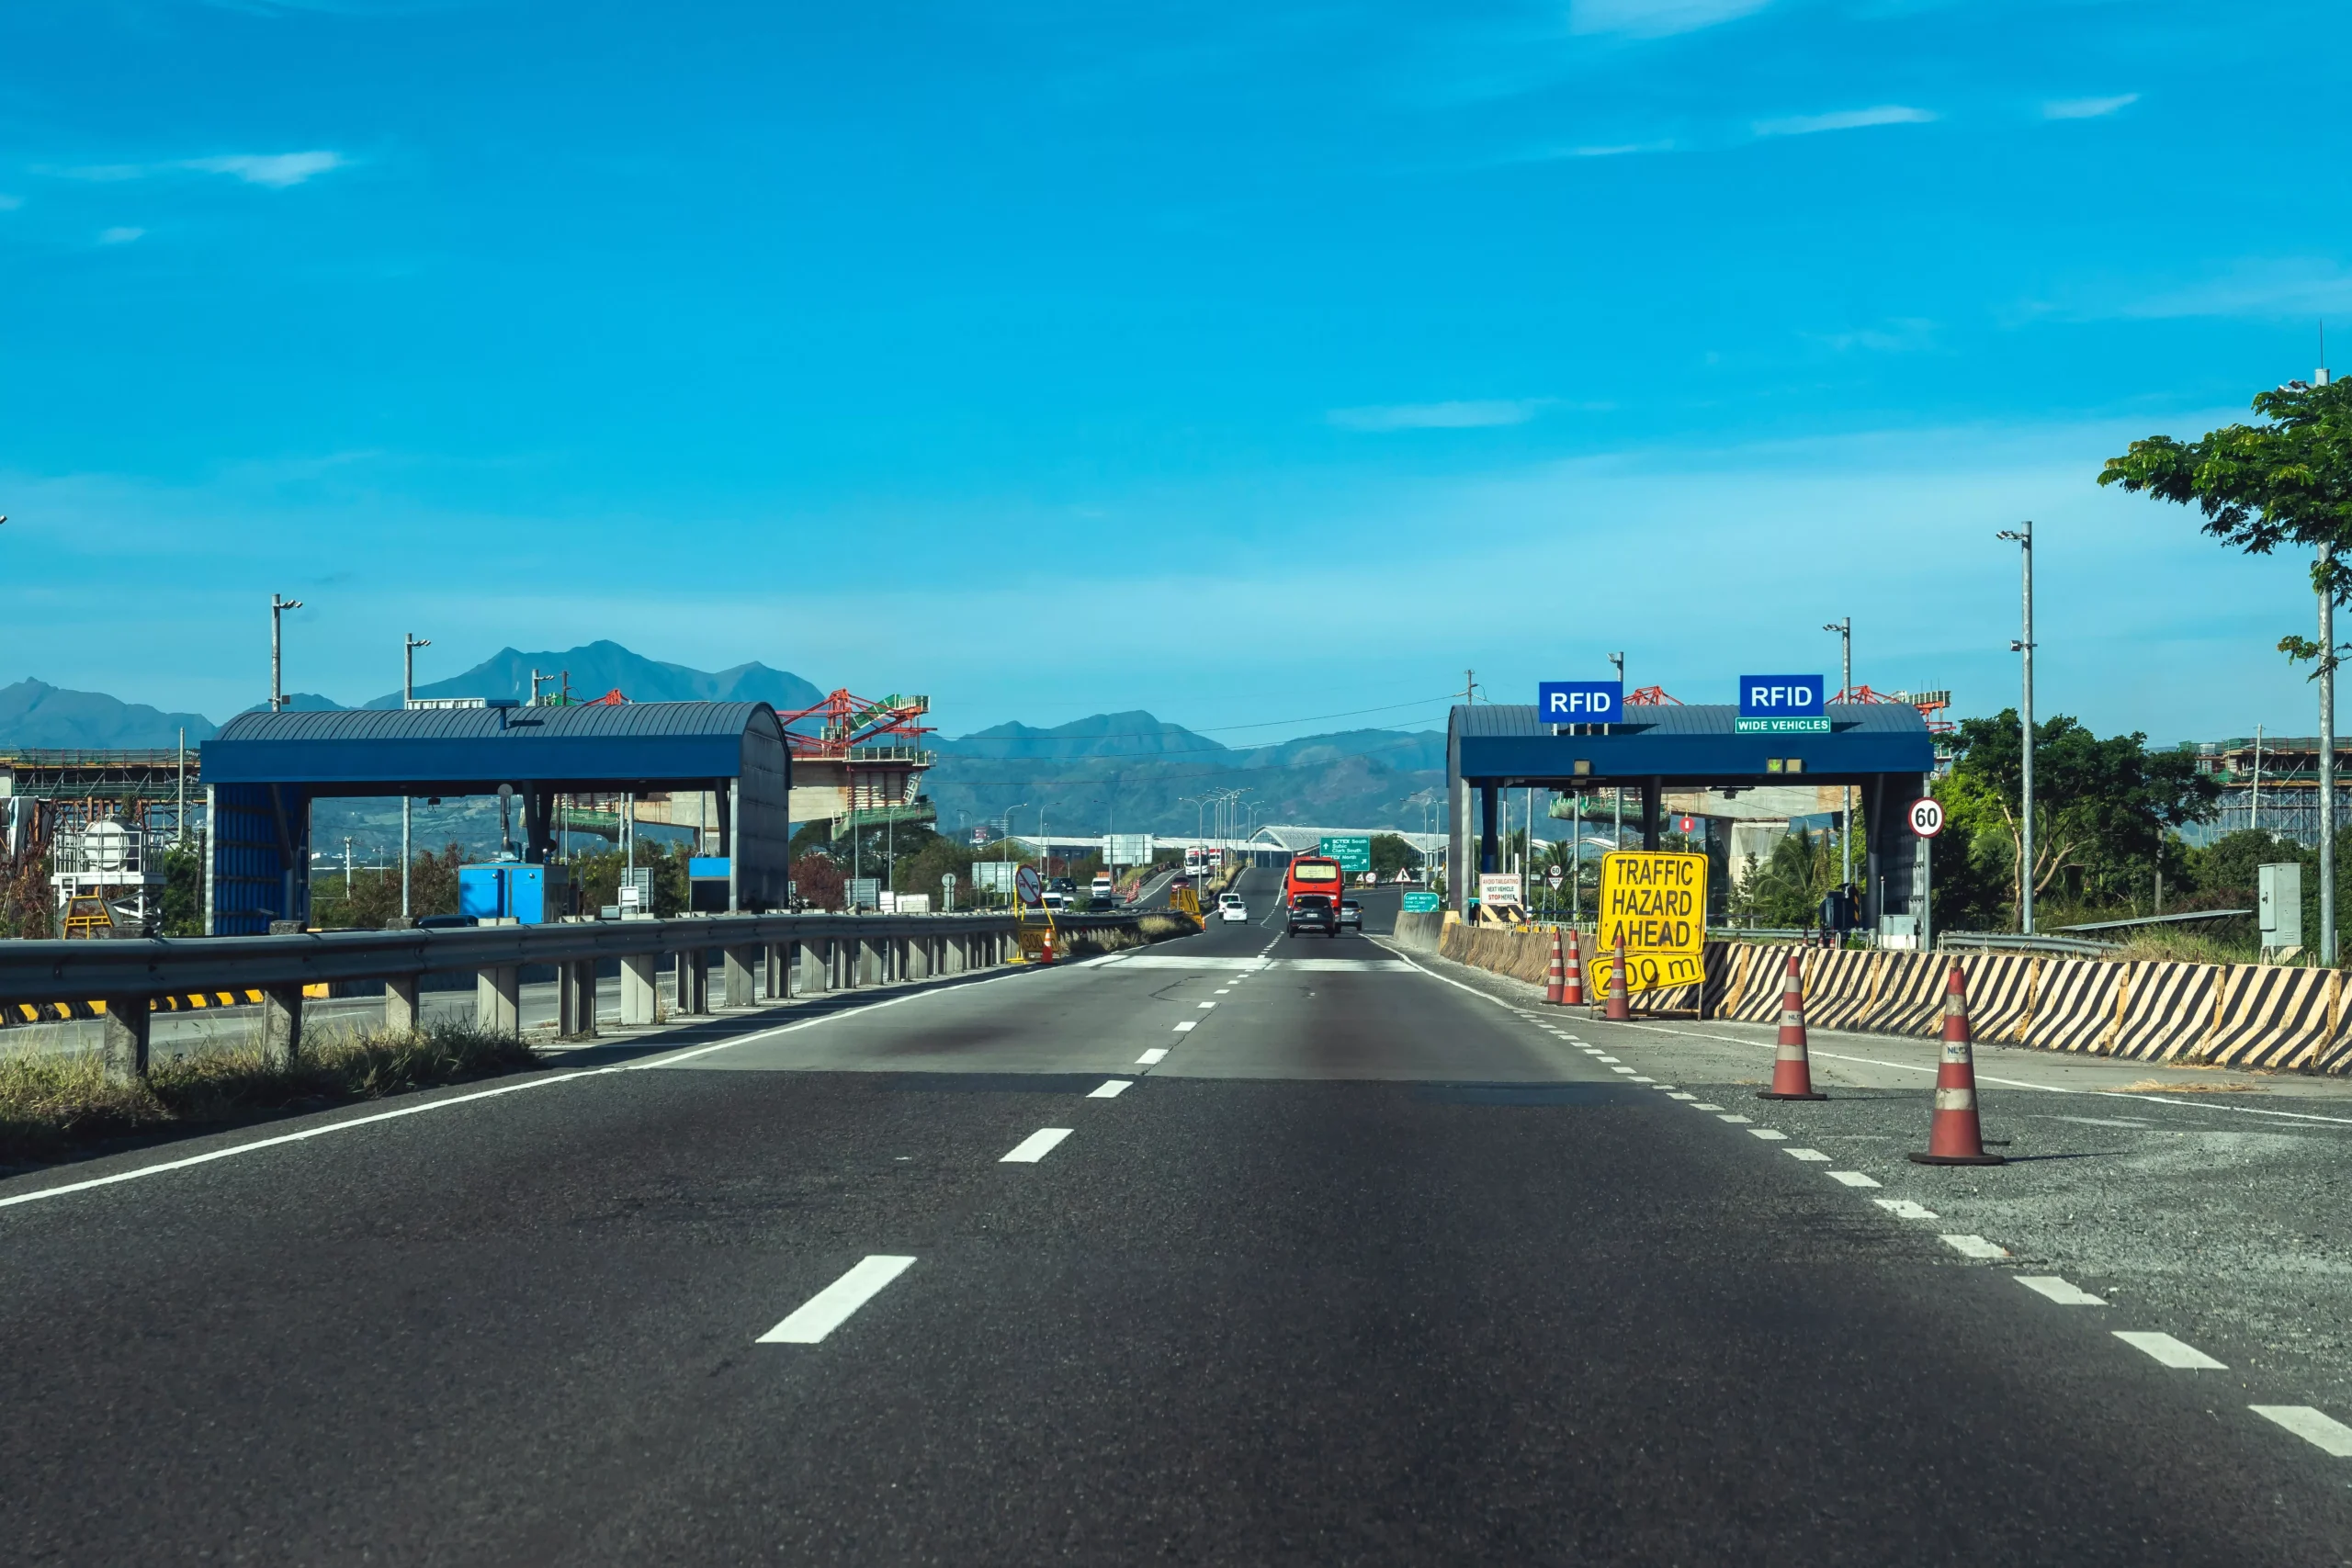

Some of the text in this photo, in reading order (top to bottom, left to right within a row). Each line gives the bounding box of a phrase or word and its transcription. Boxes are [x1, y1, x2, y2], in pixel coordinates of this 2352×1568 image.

[1550, 692, 1611, 713] RFID
[1751, 686, 1813, 707] RFID
[1738, 720, 1828, 730] WIDE VEHICLES
[1915, 807, 1938, 828] 60
[1615, 859, 1694, 886] TRAFFIC
[1611, 889, 1692, 917] HAZARD
[1023, 933, 1044, 949] 300
[1611, 919, 1690, 947] AHEAD
[1599, 957, 1696, 991] 200 m
